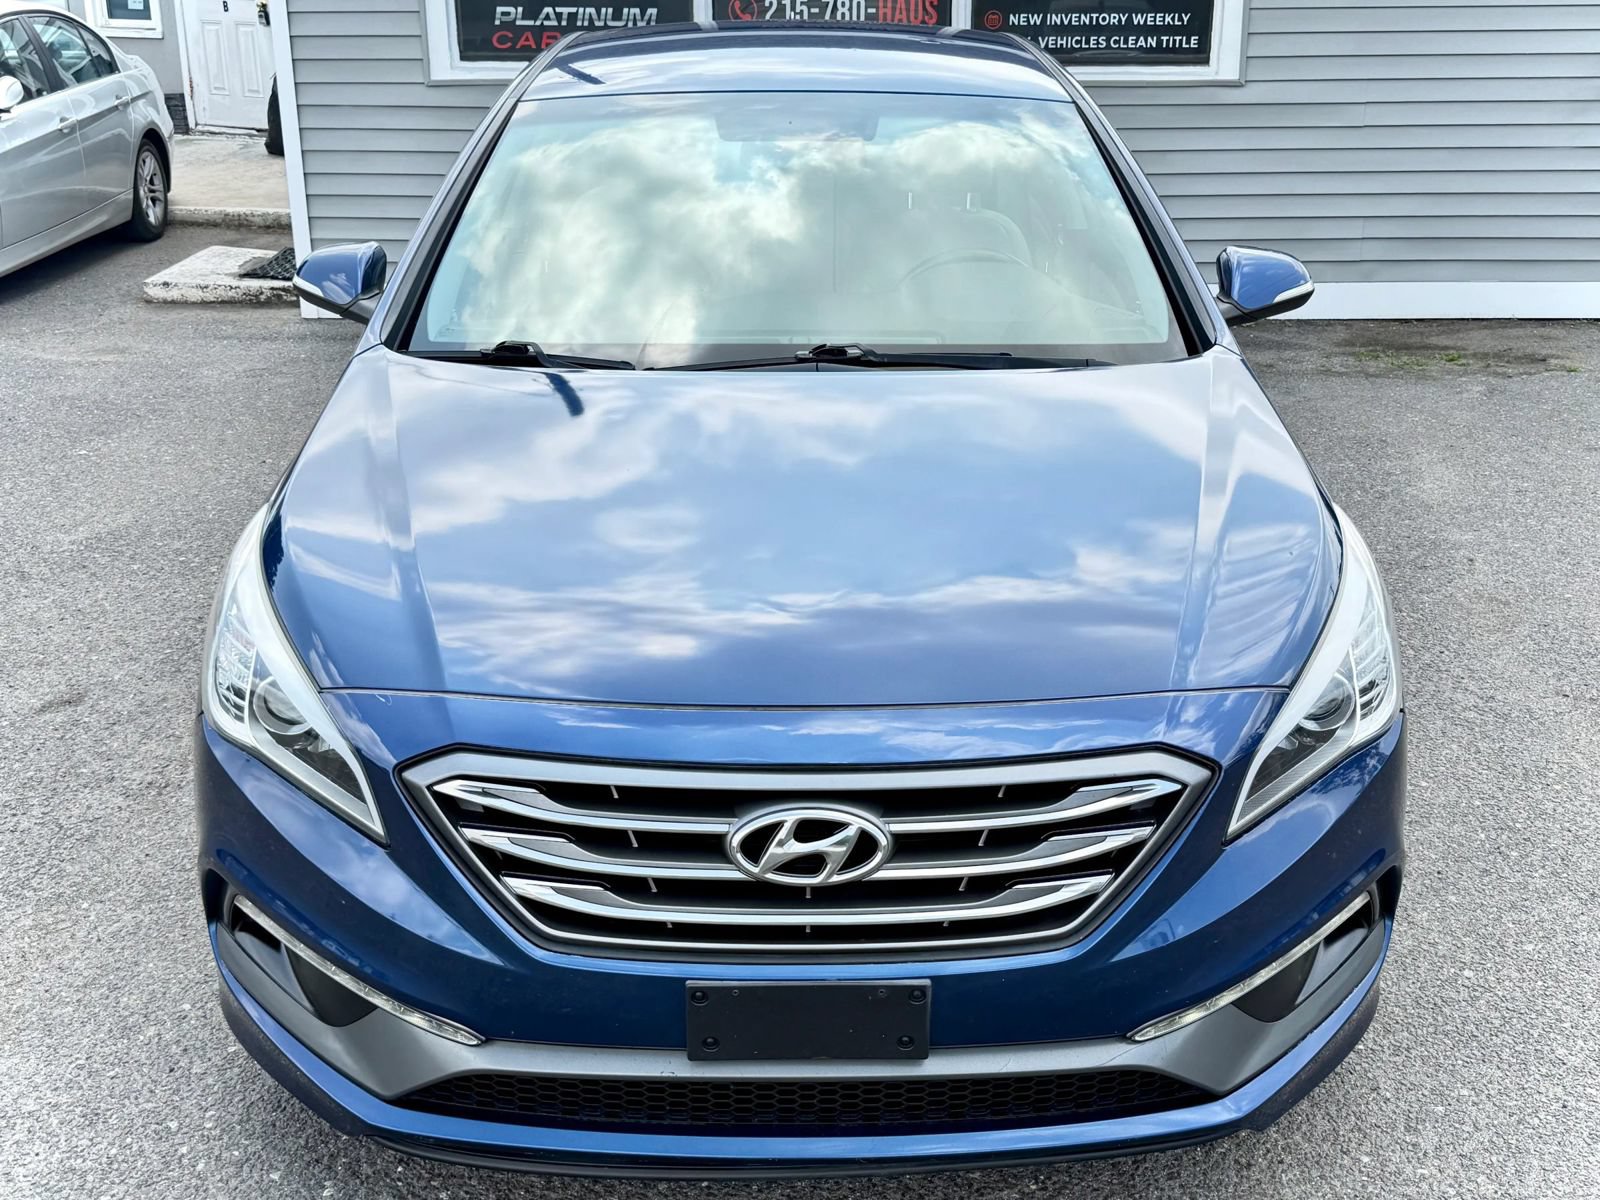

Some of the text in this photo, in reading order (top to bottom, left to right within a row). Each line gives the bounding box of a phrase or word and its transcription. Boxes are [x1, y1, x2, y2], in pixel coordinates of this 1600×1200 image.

[223, 0, 229, 12] B
[764, 0, 938, 25] 215-780-HAUS
[494, 6, 658, 27] PLATINUM
[1009, 12, 1191, 26] NEW INVENTORY WEEKLY
[1038, 36, 1107, 48] VEHICLES
[1110, 36, 1157, 48] CLEAN
[1161, 36, 1199, 48] TITLE
